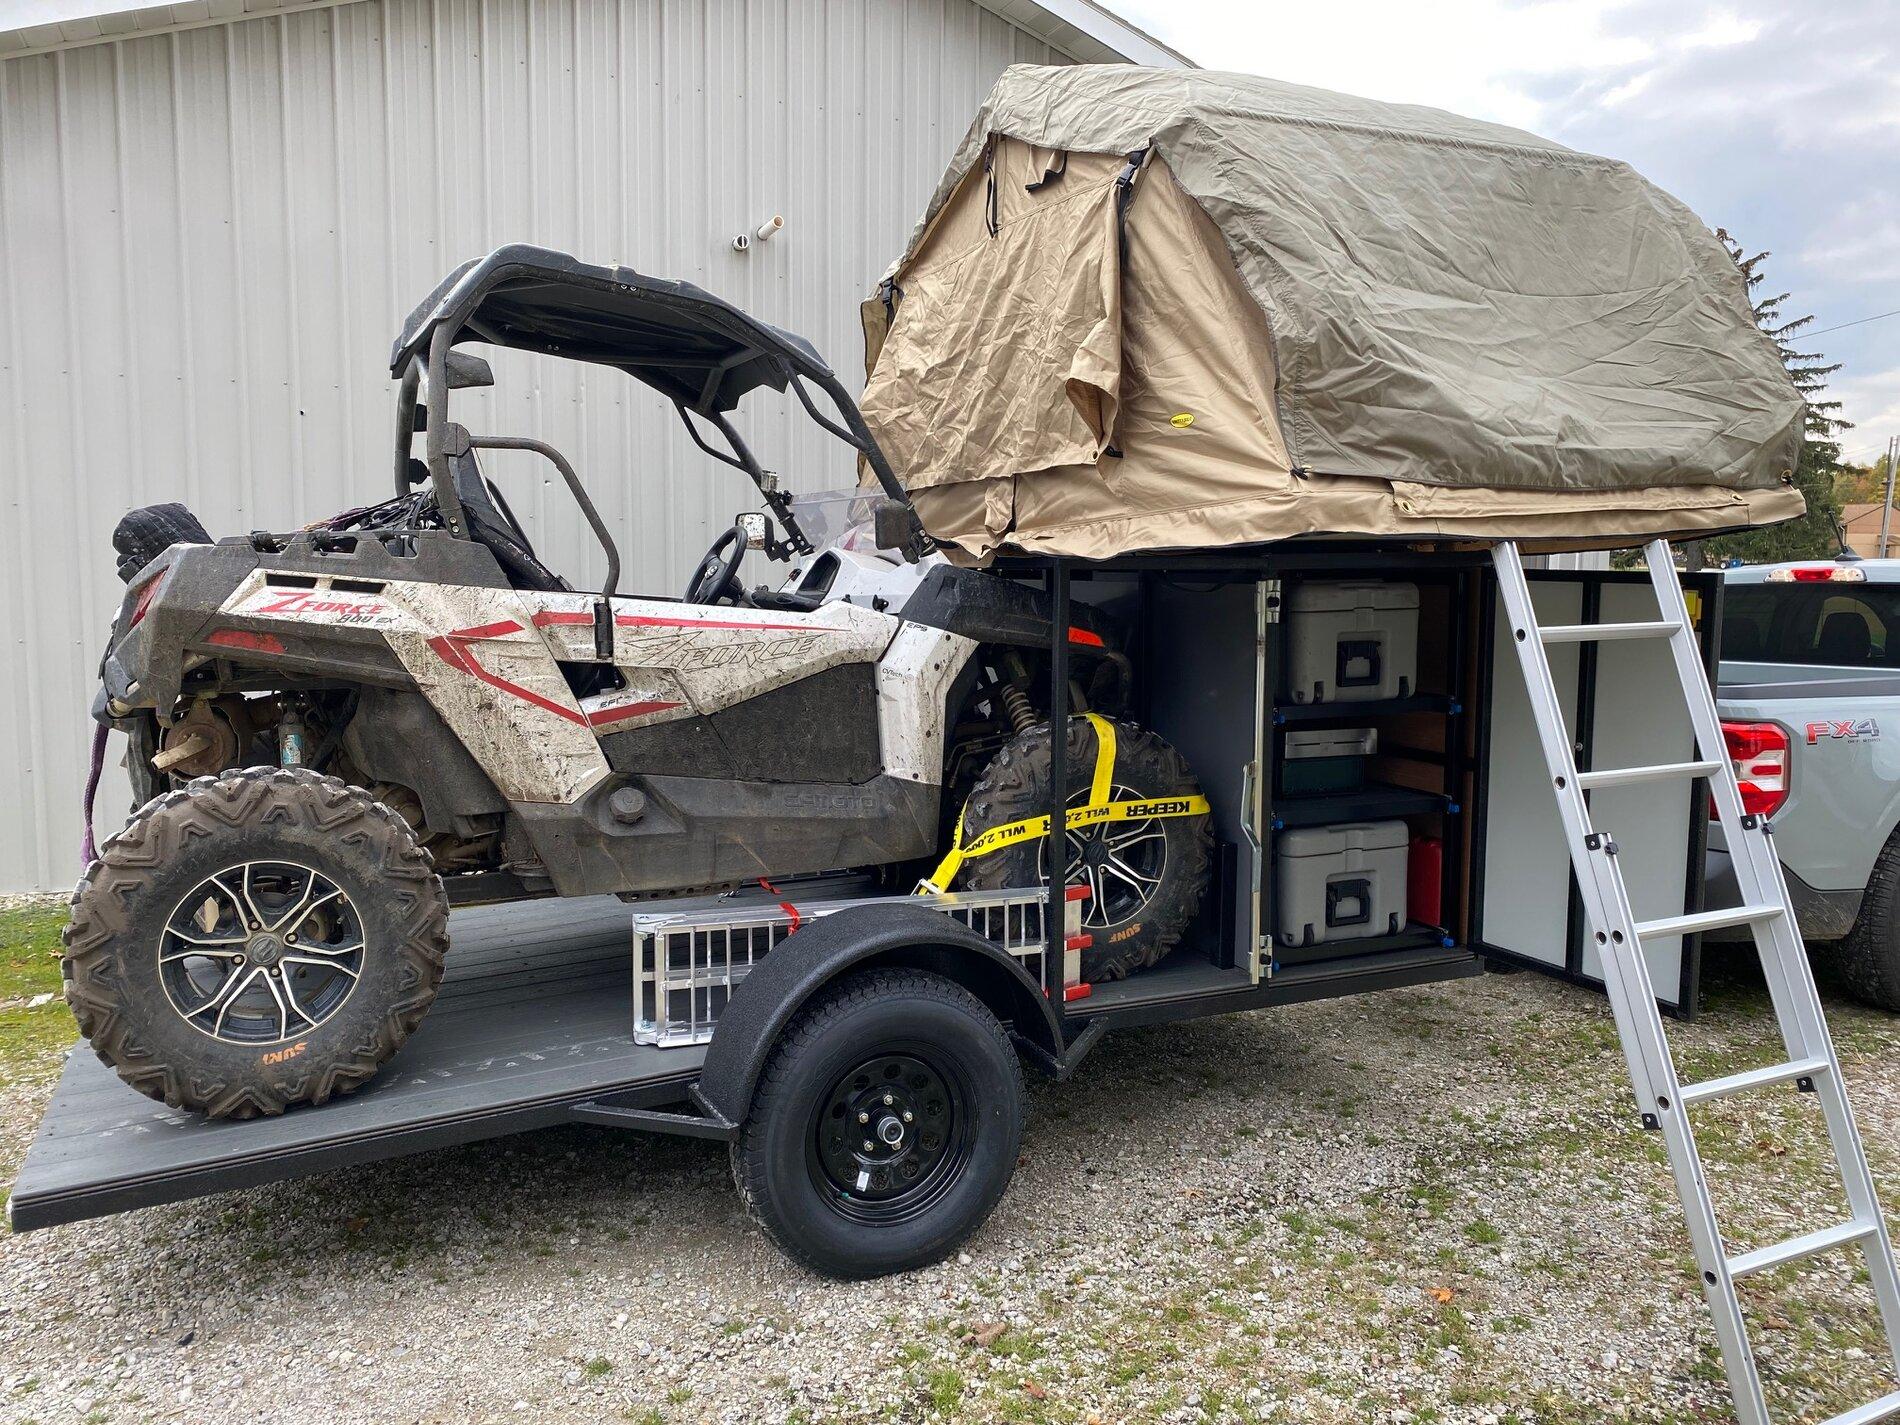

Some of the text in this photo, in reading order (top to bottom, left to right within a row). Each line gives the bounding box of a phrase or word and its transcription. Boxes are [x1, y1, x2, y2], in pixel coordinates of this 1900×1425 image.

[906, 622, 928, 632] EPS
[1804, 718, 1880, 746] FX4
[1085, 807, 1110, 819] WLL
[1125, 801, 1190, 817] KEEPER
[998, 825, 1026, 839] WLL
[1108, 922, 1143, 943] SUNF
